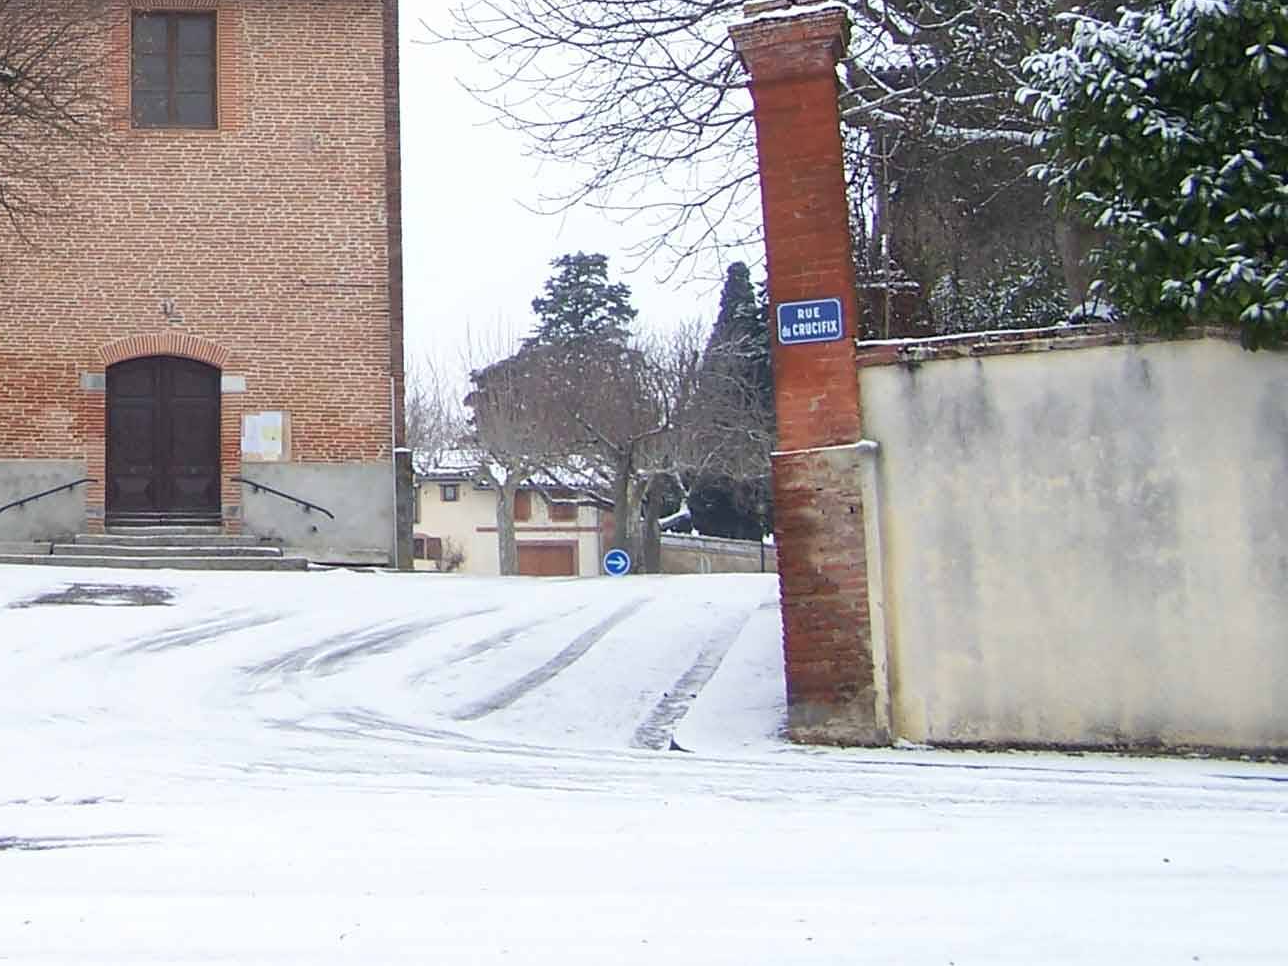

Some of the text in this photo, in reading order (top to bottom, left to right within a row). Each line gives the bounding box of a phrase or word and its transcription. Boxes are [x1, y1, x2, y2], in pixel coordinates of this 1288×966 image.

[797, 307, 820, 319] RUE
[781, 320, 838, 338] du CRUCIFIX
